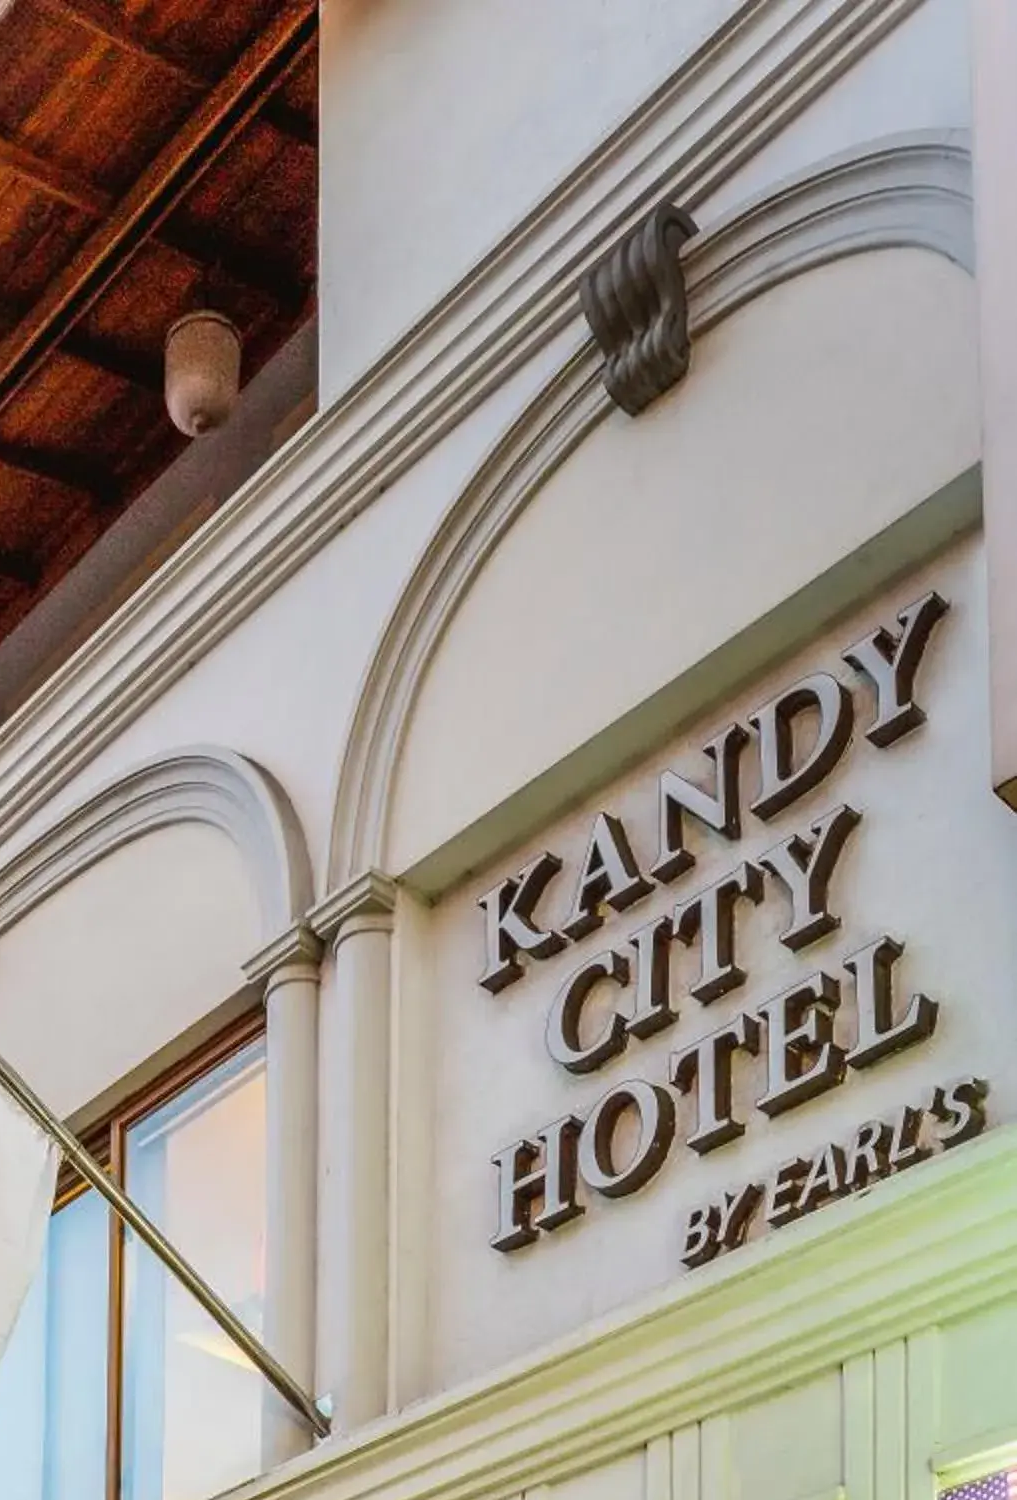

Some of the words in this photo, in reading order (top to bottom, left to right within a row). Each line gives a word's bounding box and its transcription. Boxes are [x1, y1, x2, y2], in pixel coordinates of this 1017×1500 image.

[478, 592, 950, 993] KANDY
[545, 804, 863, 1074] CITY
[490, 935, 939, 1252] HOTEL
[680, 1183, 765, 1270] BY
[766, 1077, 989, 1229] EARL'S
